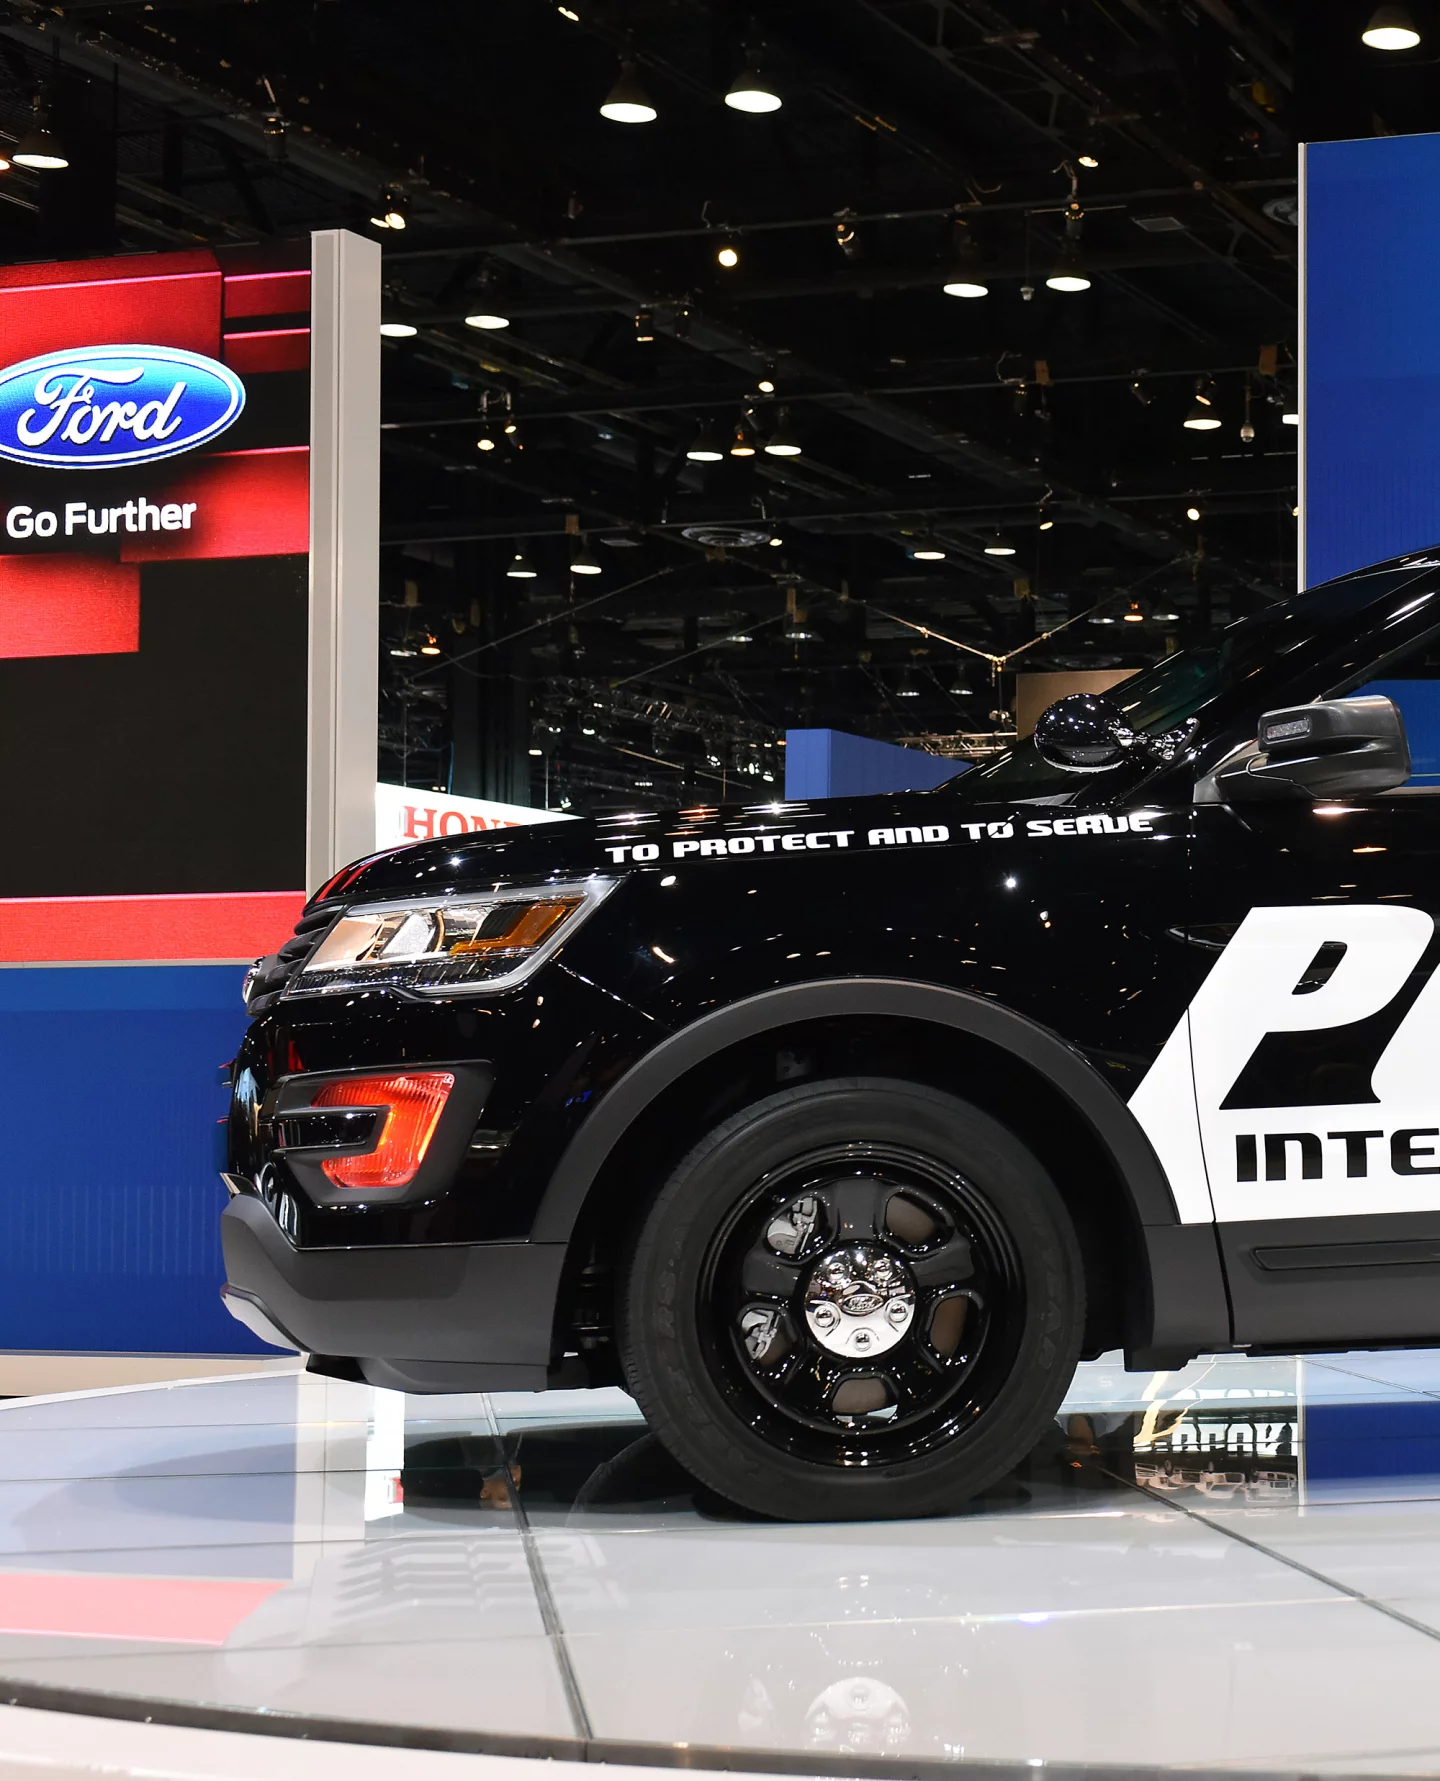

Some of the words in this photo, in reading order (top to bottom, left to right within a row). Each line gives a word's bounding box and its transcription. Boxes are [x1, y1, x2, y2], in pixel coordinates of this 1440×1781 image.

[16, 366, 187, 447] Ford
[6, 505, 58, 539] Go
[65, 497, 197, 536] Further
[403, 805, 522, 840] HO
[604, 843, 660, 864] TO
[672, 830, 855, 858] PROTECT
[867, 825, 950, 846] AND
[960, 821, 1014, 840] TO
[1026, 814, 1154, 837] SERVE
